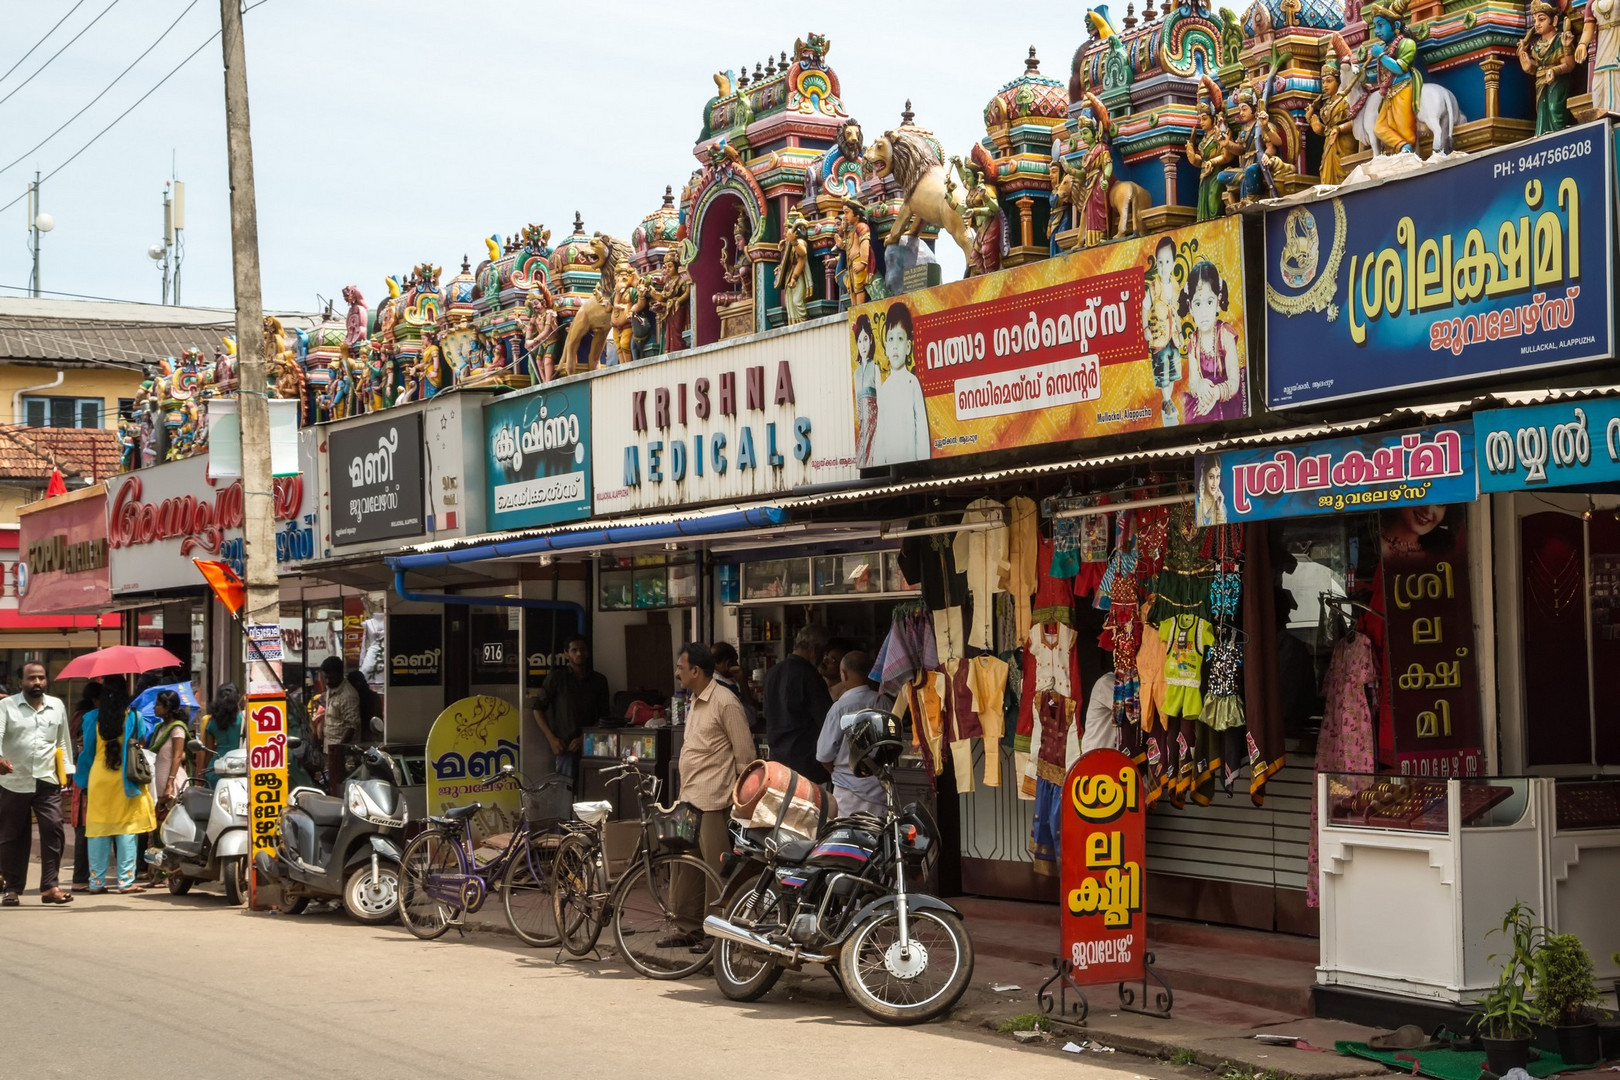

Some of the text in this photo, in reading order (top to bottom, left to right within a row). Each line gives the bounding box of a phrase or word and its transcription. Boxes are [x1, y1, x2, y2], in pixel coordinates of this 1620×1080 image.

[1518, 139, 1592, 174] 9447566208
[1348, 176, 1580, 345] ശ്രീലക്ഷ്മി
[926, 331, 986, 370] വത്സാ
[1520, 335, 1596, 355] MULLACKAL, ALAPPUZHA
[632, 360, 795, 431] KRISHNA
[959, 361, 1098, 410] റെഡിമെയ്ഡ് സെന്റർ
[623, 417, 811, 487] MEDICALS
[1485, 407, 1591, 483] തയ്യൽ
[1231, 429, 1464, 514] ശ്രീലക്ഷ്മി
[27, 534, 67, 575] GOPU
[484, 645, 502, 660] 916
